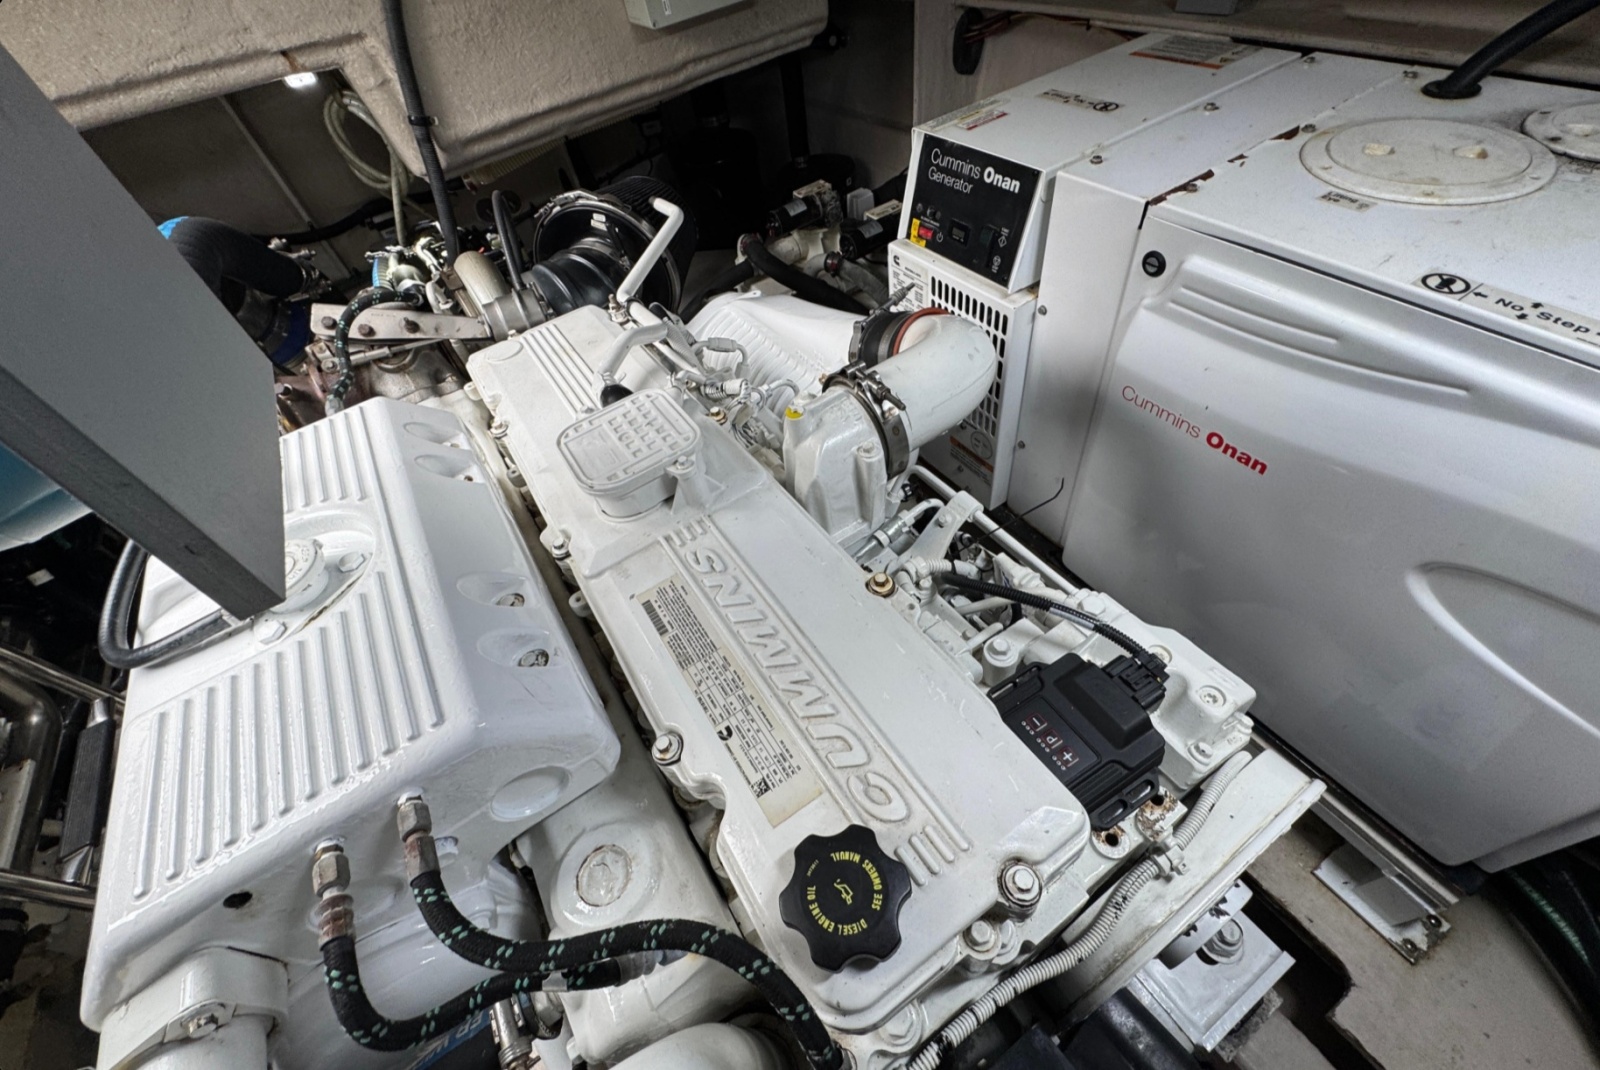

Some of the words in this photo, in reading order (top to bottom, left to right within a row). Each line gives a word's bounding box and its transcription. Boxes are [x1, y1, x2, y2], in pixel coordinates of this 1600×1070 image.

[928, 166, 973, 194] Generator
[931, 148, 981, 179] Cummins
[983, 166, 1021, 194] Onan
[1495, 298, 1524, 312] No
[1536, 311, 1590, 334] Step
[1122, 385, 1201, 439] Cummins
[1206, 431, 1268, 475] Onan
[684, 548, 911, 823] CUMMINS
[830, 851, 861, 863] MANUAL
[862, 859, 883, 891] OWNERS
[806, 885, 816, 900] OIL
[871, 893, 883, 911] SEE
[809, 902, 835, 932] ENGINE
[837, 918, 868, 936] DIESEL
